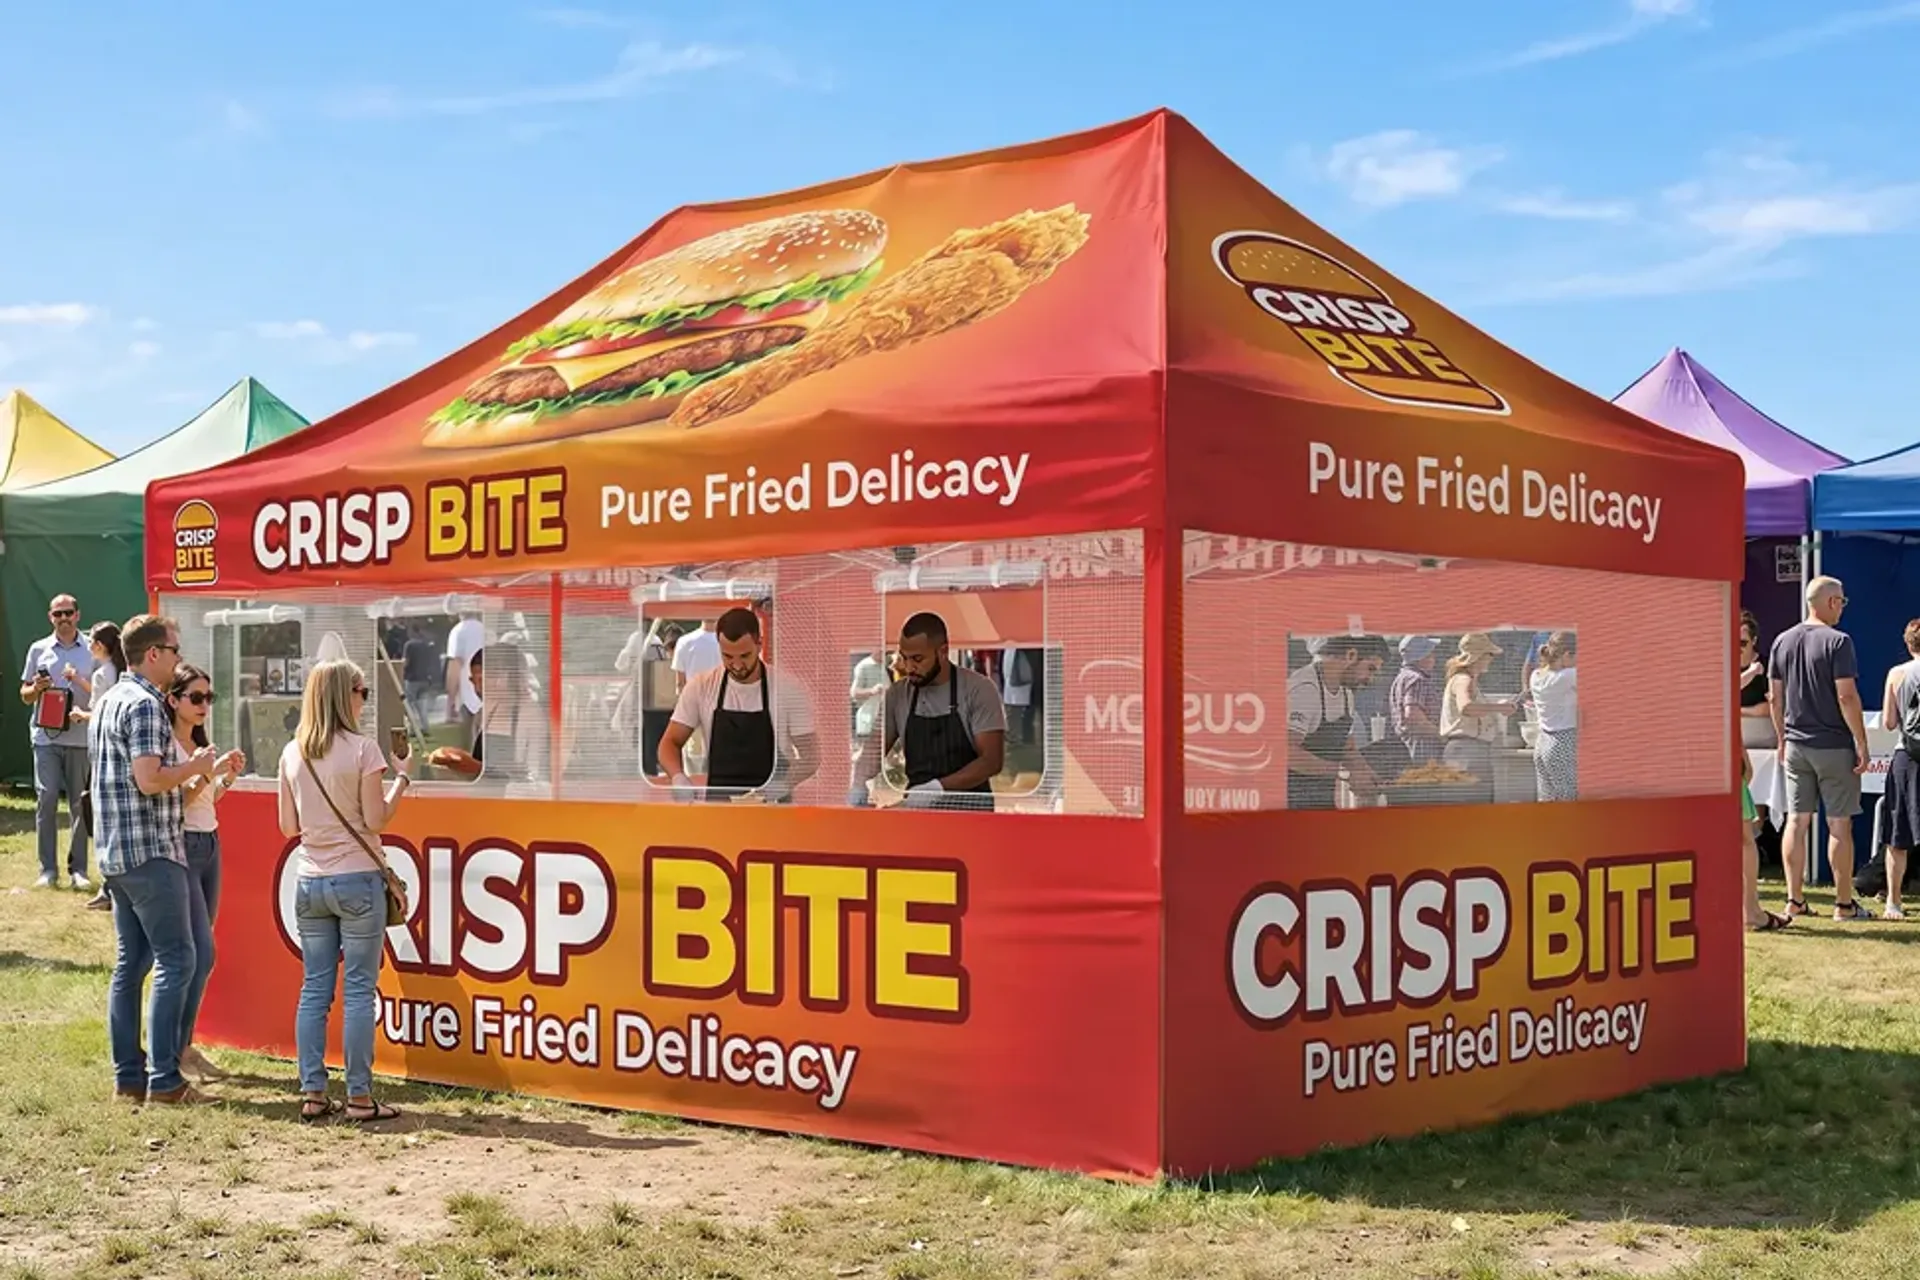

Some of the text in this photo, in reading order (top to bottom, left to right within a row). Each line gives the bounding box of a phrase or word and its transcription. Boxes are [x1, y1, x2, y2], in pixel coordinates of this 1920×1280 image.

[1251, 286, 1413, 336] CRISP
[1300, 325, 1472, 383] BITE
[252, 473, 564, 570] CRISP BITE
[600, 449, 1030, 528] Pure Fried Delicacy
[1308, 441, 1663, 544] Pure Fried Delicacy
[174, 528, 217, 547] CRISP
[175, 547, 215, 569] BITE
[651, 857, 960, 1012] BITE
[1231, 859, 1696, 1020] CRISP BITE
[374, 989, 857, 1109] ure Fried Delicacy
[1304, 997, 1648, 1096] Pure Fried Delicacy
